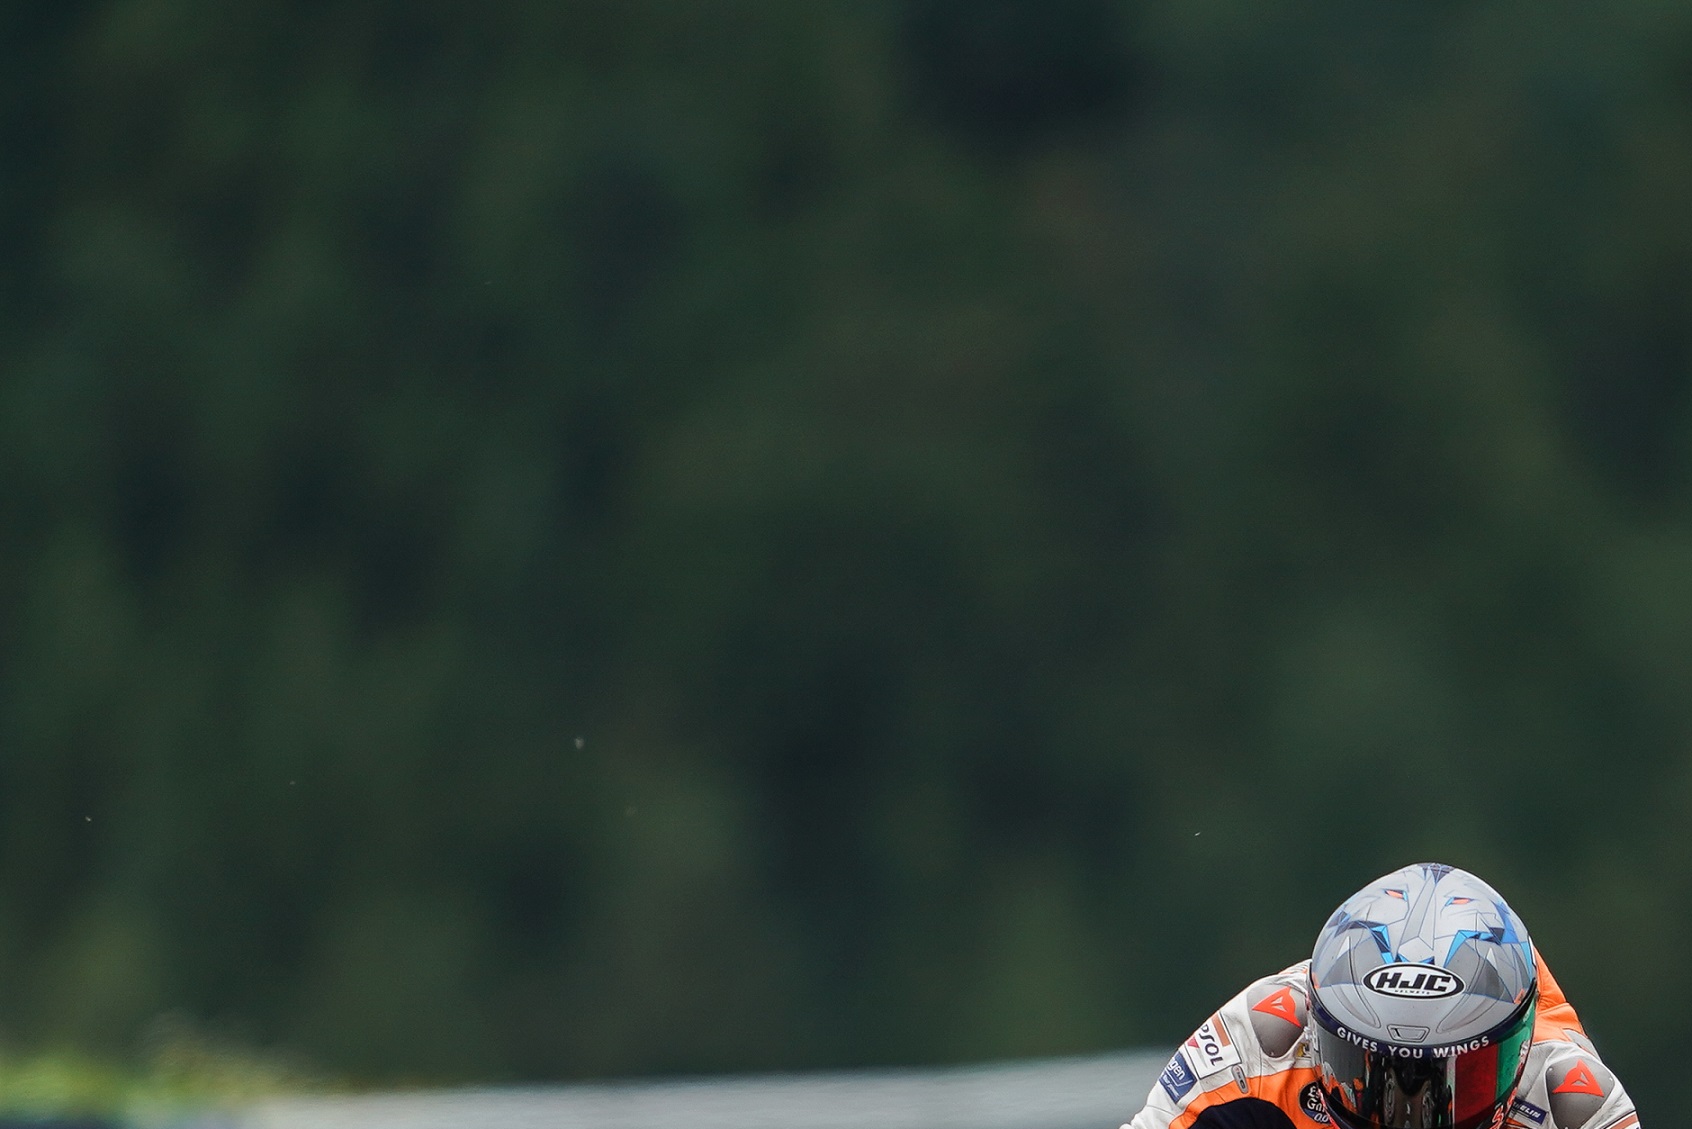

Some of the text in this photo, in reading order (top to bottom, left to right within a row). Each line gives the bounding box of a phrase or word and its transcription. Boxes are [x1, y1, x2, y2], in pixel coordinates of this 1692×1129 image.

[1376, 972, 1452, 992] HJC
[1199, 1024, 1223, 1067] PSOL
[1337, 1027, 1490, 1059] GIVES YOU WINGS
